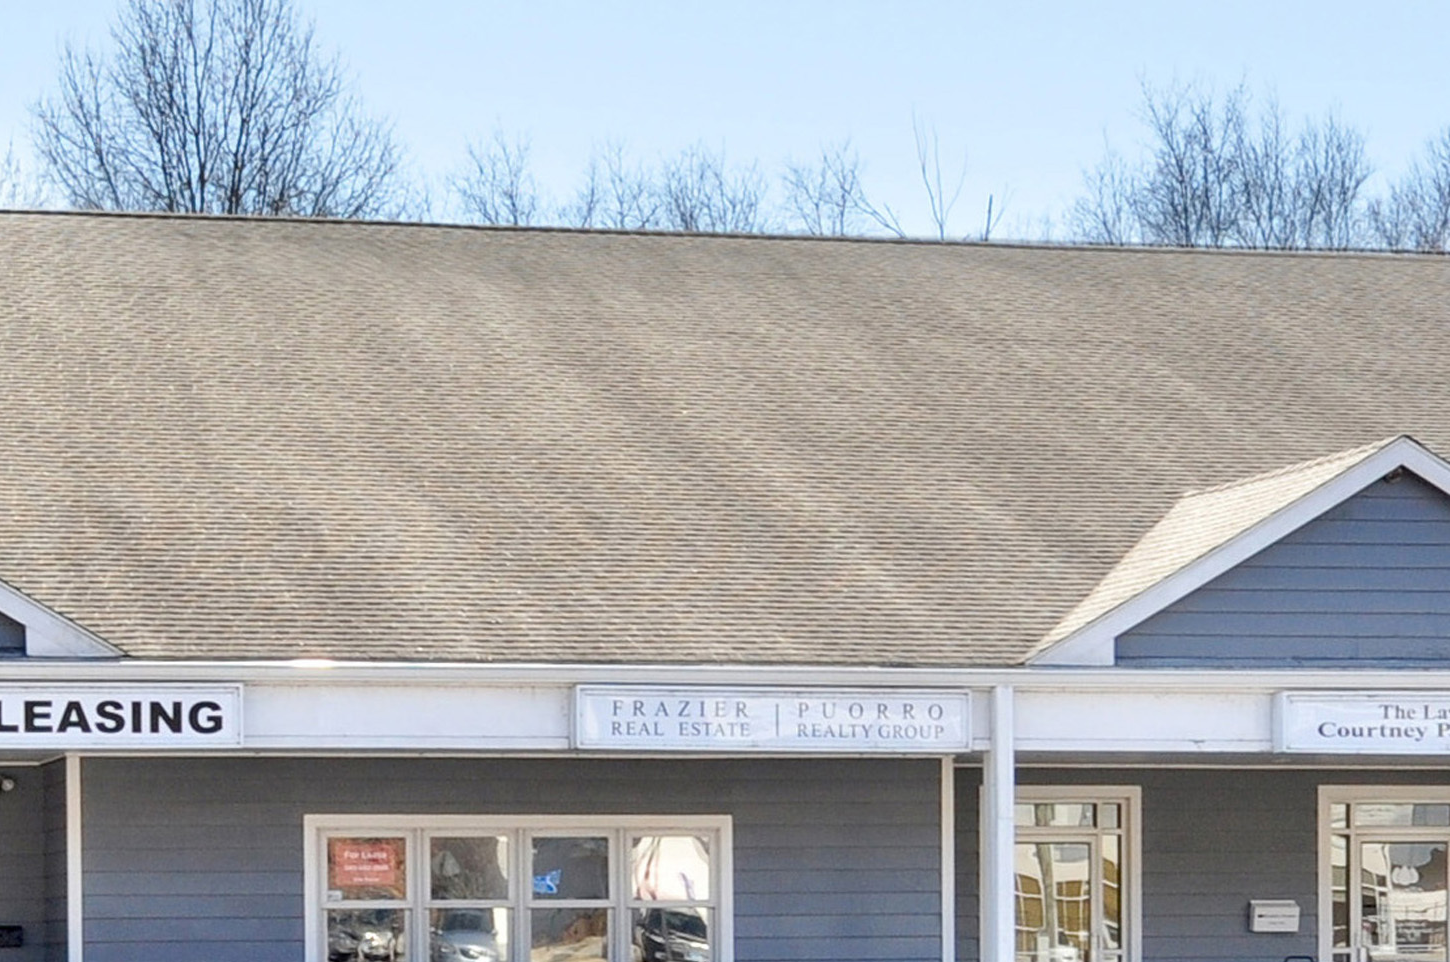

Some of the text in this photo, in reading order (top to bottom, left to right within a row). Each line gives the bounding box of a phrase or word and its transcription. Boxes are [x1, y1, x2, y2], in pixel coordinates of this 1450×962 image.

[612, 700, 749, 718] FRAZIER
[797, 703, 944, 720] PUORRO
[1379, 704, 1416, 720] The
[611, 722, 751, 737] REAL ESTATE
[796, 724, 945, 740] REALTY GROUP
[1317, 722, 1450, 742] Courtney P
